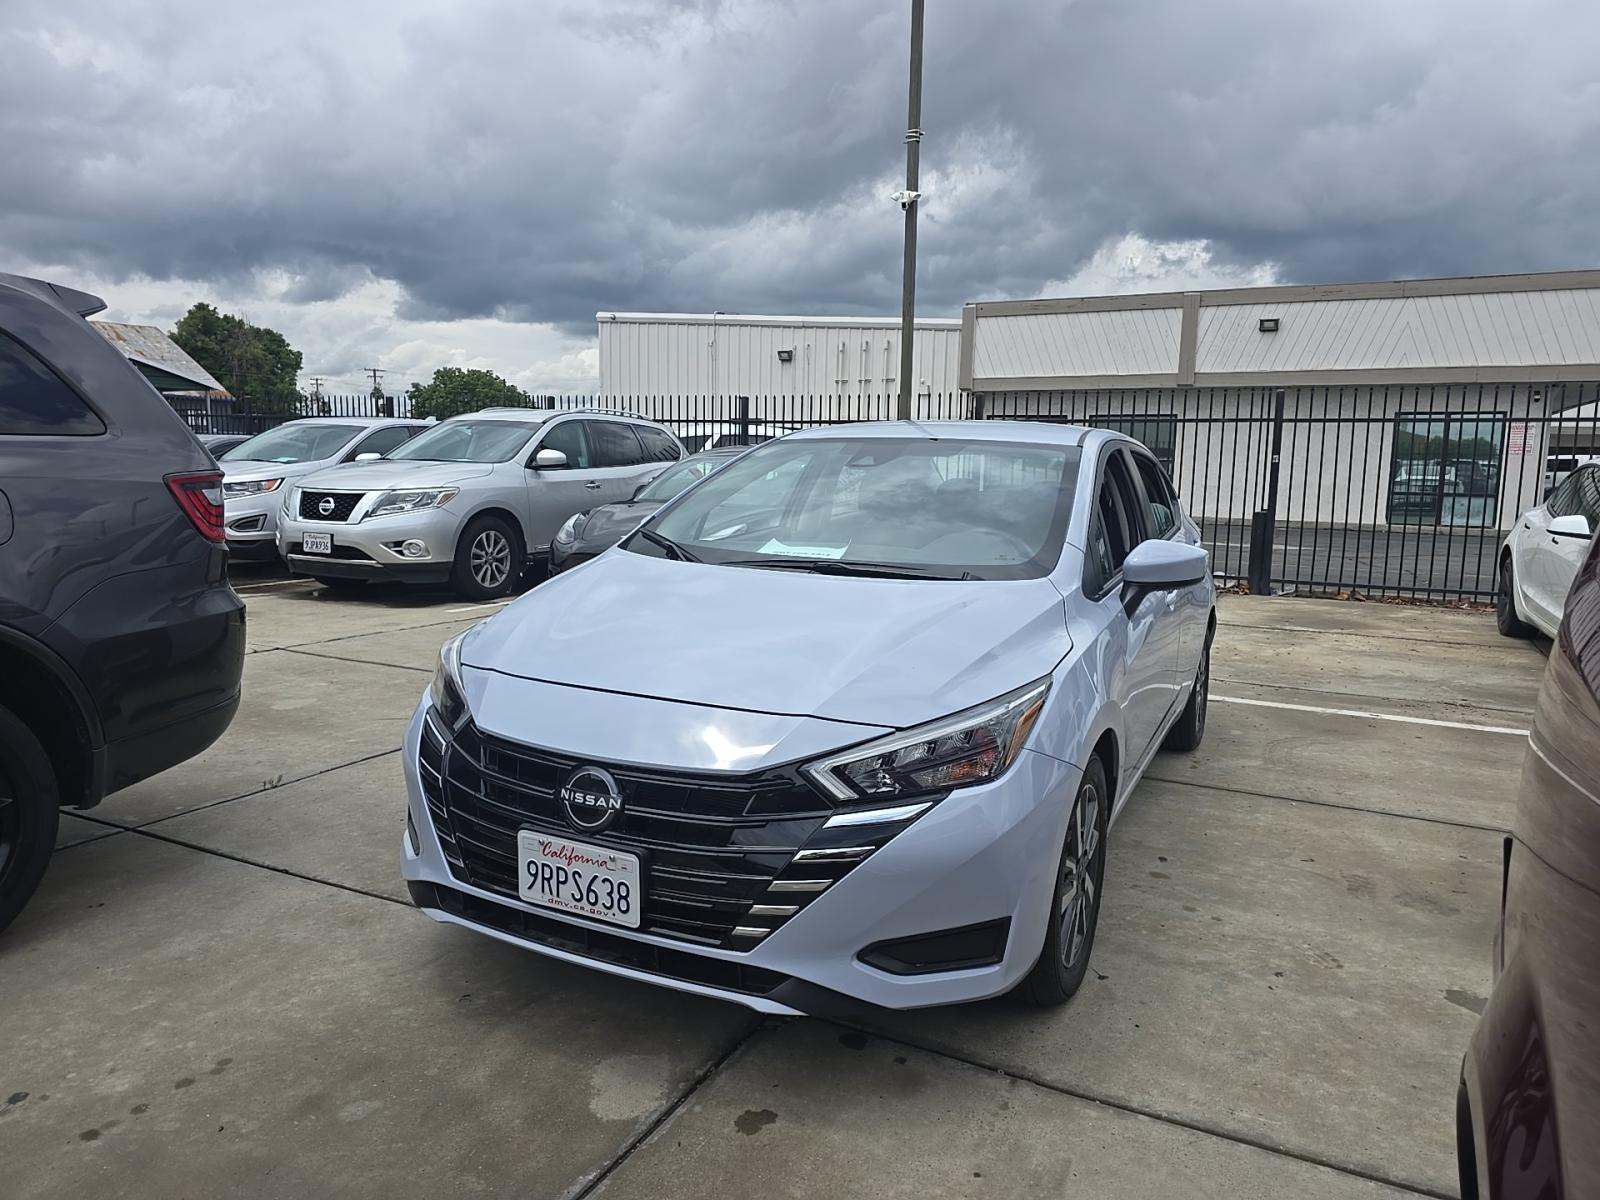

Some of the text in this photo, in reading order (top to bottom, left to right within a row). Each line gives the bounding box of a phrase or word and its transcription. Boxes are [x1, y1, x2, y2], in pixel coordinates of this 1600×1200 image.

[560, 788, 621, 809] NISSAN
[542, 841, 616, 872] California
[526, 860, 630, 915] 9RPS638
[547, 897, 609, 917] dmv.ca.gov
